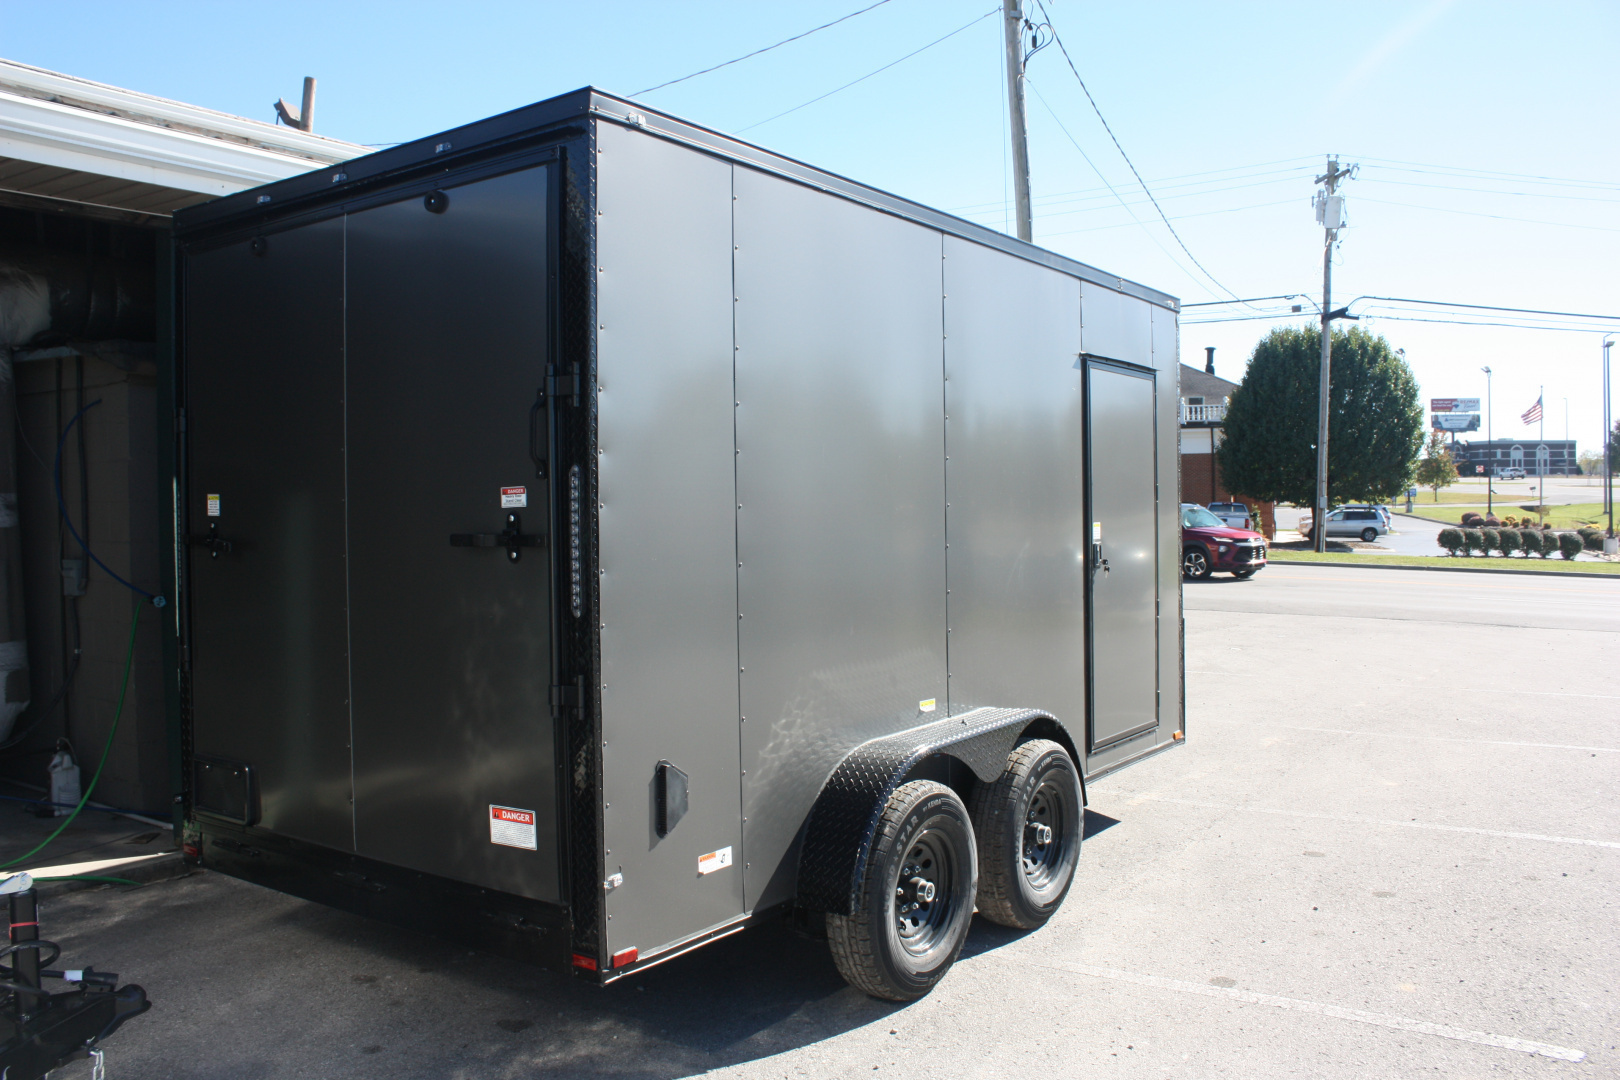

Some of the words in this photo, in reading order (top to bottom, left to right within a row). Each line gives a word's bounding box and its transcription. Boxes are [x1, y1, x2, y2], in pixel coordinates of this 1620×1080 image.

[502, 810, 530, 822] DANGER
[896, 815, 919, 855] STAR
[927, 798, 942, 809] KENDA
